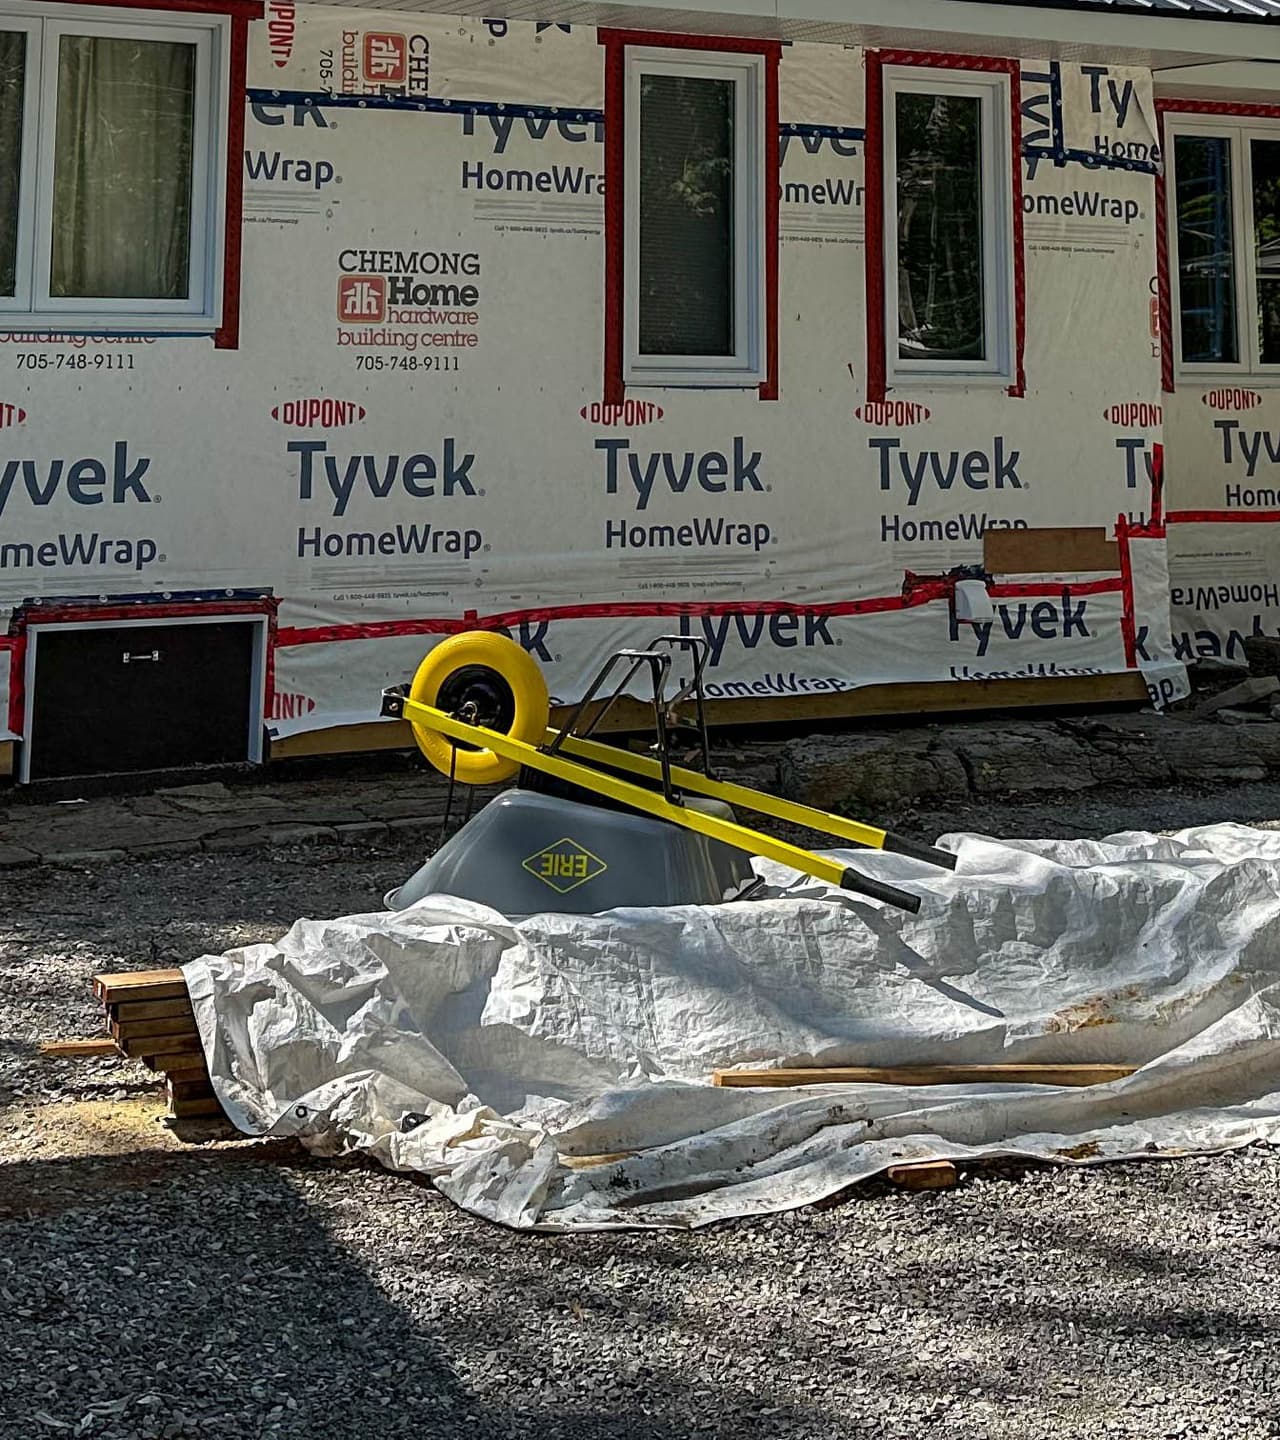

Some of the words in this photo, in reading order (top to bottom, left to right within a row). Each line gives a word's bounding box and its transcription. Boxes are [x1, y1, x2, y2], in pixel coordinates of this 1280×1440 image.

[338, 249, 480, 275] CHEMONG
[387, 276, 479, 306] Home
[387, 307, 479, 325] hardware
[337, 328, 418, 351] building
[421, 330, 479, 348] centre
[16, 353, 135, 371] 705-748-9111
[356, 356, 460, 371] 705-748-9111
[1208, 389, 1256, 411] DUPONT
[283, 399, 356, 428] DUPONT
[864, 402, 924, 427] DUPONT
[287, 437, 476, 516] Tyvek
[594, 436, 763, 510] Tyvek
[868, 436, 1022, 506] Tyvek
[298, 524, 482, 558] HomeWrap
[606, 517, 770, 551] HomeWrap
[541, 853, 588, 876] ERIE
